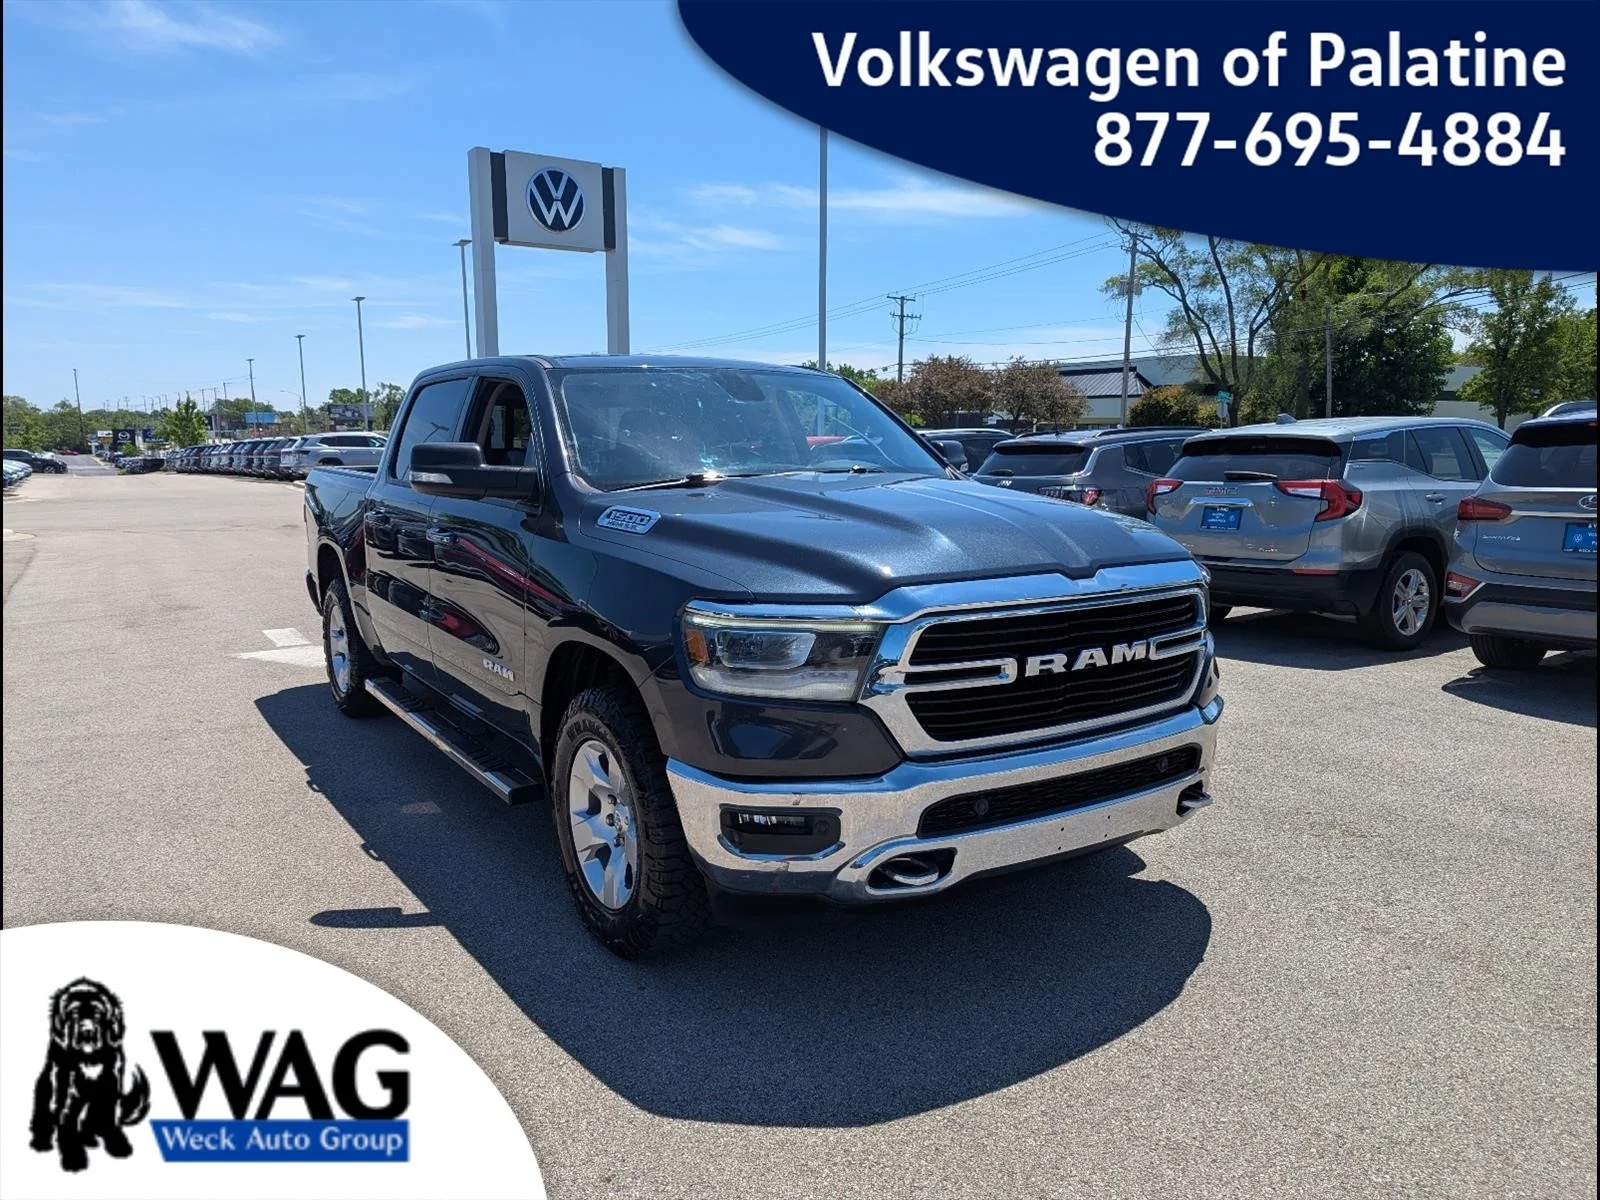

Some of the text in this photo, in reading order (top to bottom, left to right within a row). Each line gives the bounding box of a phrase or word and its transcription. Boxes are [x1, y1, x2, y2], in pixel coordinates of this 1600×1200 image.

[610, 510, 650, 526] 1500
[482, 658, 514, 682] RAM
[1024, 640, 1148, 678] RAM
